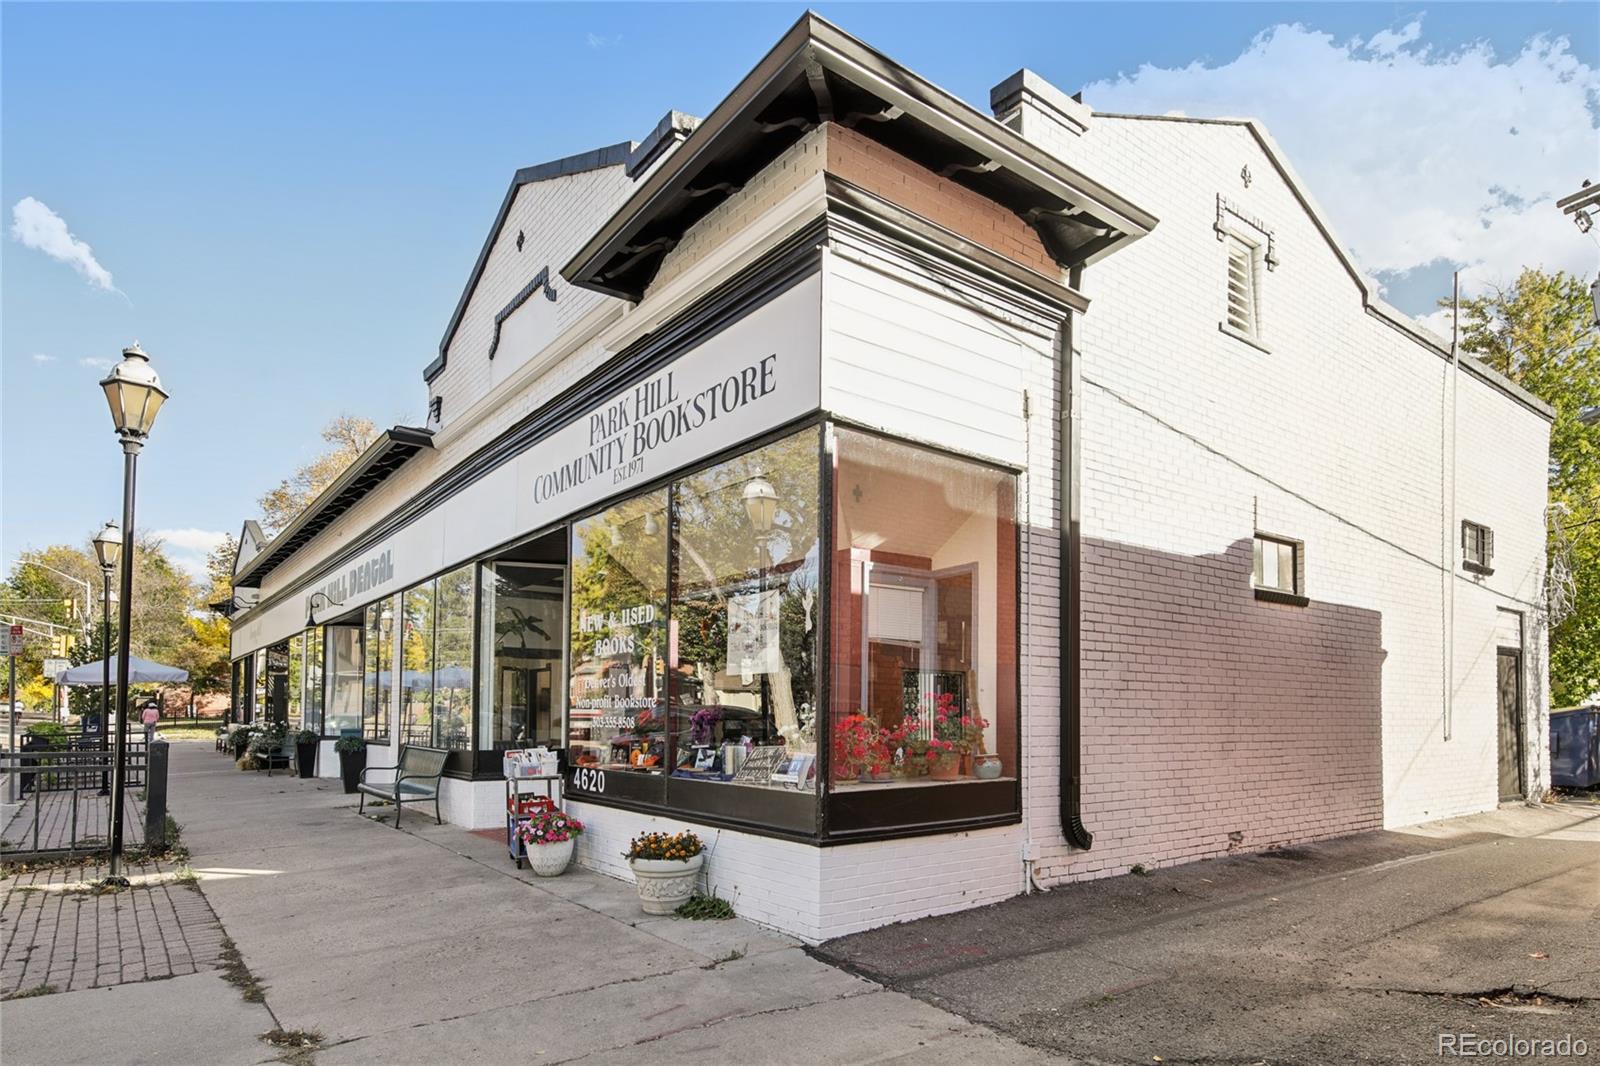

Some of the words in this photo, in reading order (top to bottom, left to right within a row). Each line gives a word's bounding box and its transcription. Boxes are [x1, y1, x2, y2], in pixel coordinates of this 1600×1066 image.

[588, 398, 629, 448] PARK
[634, 371, 679, 421] HILL
[533, 433, 627, 504] COMMUNITY
[633, 354, 776, 457] BOOKSTORE
[580, 612, 603, 632] NEW
[622, 604, 654, 627] USED
[594, 634, 635, 656] BOOKS
[614, 694, 657, 709] Bookstore
[573, 767, 605, 793] 4620
